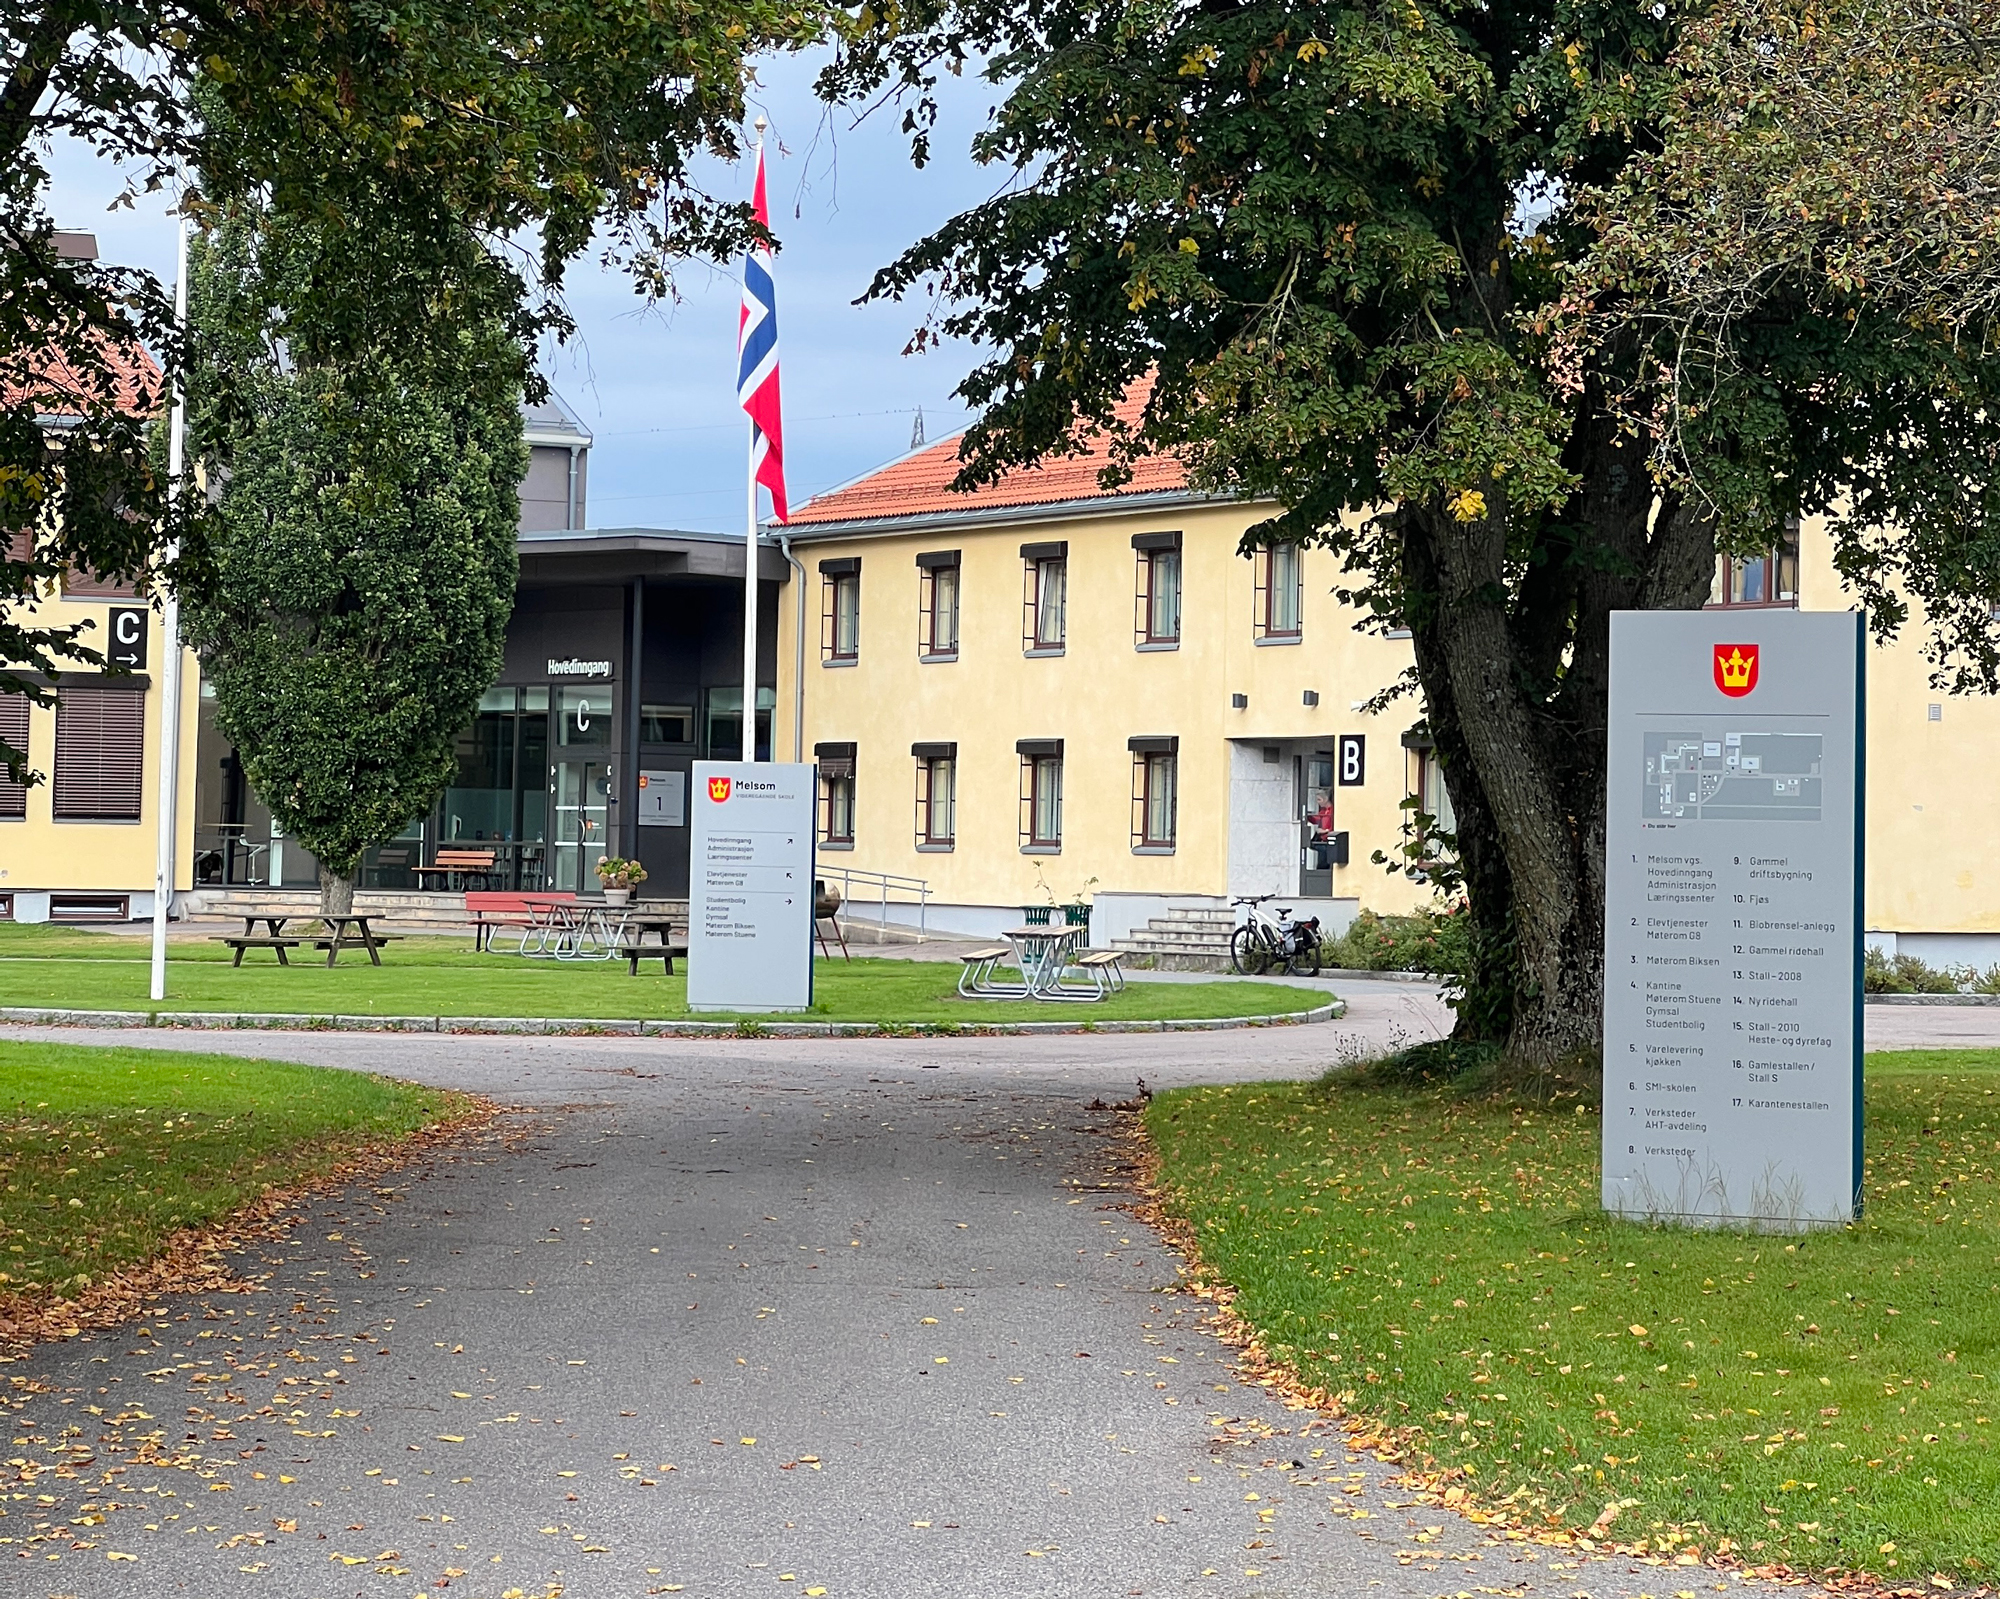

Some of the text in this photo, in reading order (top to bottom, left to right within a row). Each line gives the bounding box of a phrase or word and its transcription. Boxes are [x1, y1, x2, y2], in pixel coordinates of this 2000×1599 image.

[116, 611, 140, 645] C
[547, 658, 609, 677] Hovedinngang
[577, 699, 590, 732] C
[1343, 740, 1360, 781] B
[656, 796, 662, 811] 1
[1631, 855, 1703, 866] 1. Melsom vgs.
[1733, 857, 1788, 866] 9. Gammel
[1647, 867, 1713, 879] Hovedinngang
[1749, 869, 1812, 881] driftsbygning
[1647, 880, 1717, 892] Administrasjon
[1647, 893, 1715, 904] Læringssenter
[1733, 894, 1769, 905] 10. Fjøs
[1631, 918, 1708, 929] 2. Elevtjenester
[1733, 919, 1835, 933] 11. Biobrensel-anlegg
[1646, 930, 1701, 941] Møterom G8
[1733, 945, 1823, 956] 12. Gammel ridehall
[1630, 955, 1720, 966] 3. Møterom Biksen
[1732, 971, 1745, 980] 13.
[1748, 971, 1770, 980] Stall
[1630, 981, 1682, 990] 4. Kantine
[1646, 994, 1721, 1004] Møterom Stuene
[1732, 996, 1798, 1007] 14. Ny ridehall
[1645, 1006, 1680, 1018] Gymsal
[1645, 1019, 1705, 1031] Studentbolig
[1732, 1022, 1744, 1031] 15.
[1748, 1022, 1770, 1032] Stall
[1748, 1035, 1832, 1047] Heste- og dyrefag
[1629, 1044, 1703, 1056] 5. Varelevering
[1645, 1057, 1681, 1068] kjøkken
[1732, 1059, 1744, 1069] 16.
[1748, 1073, 1778, 1083] Stall S
[1629, 1082, 1696, 1093] 6. SMI-skolen
[1732, 1098, 1829, 1110] 17. Karantenestallen
[1629, 1107, 1696, 1118] 7. Verksteder
[1645, 1120, 1707, 1133] AHT-avdeling
[1628, 1145, 1696, 1156] 8. Verksteder
